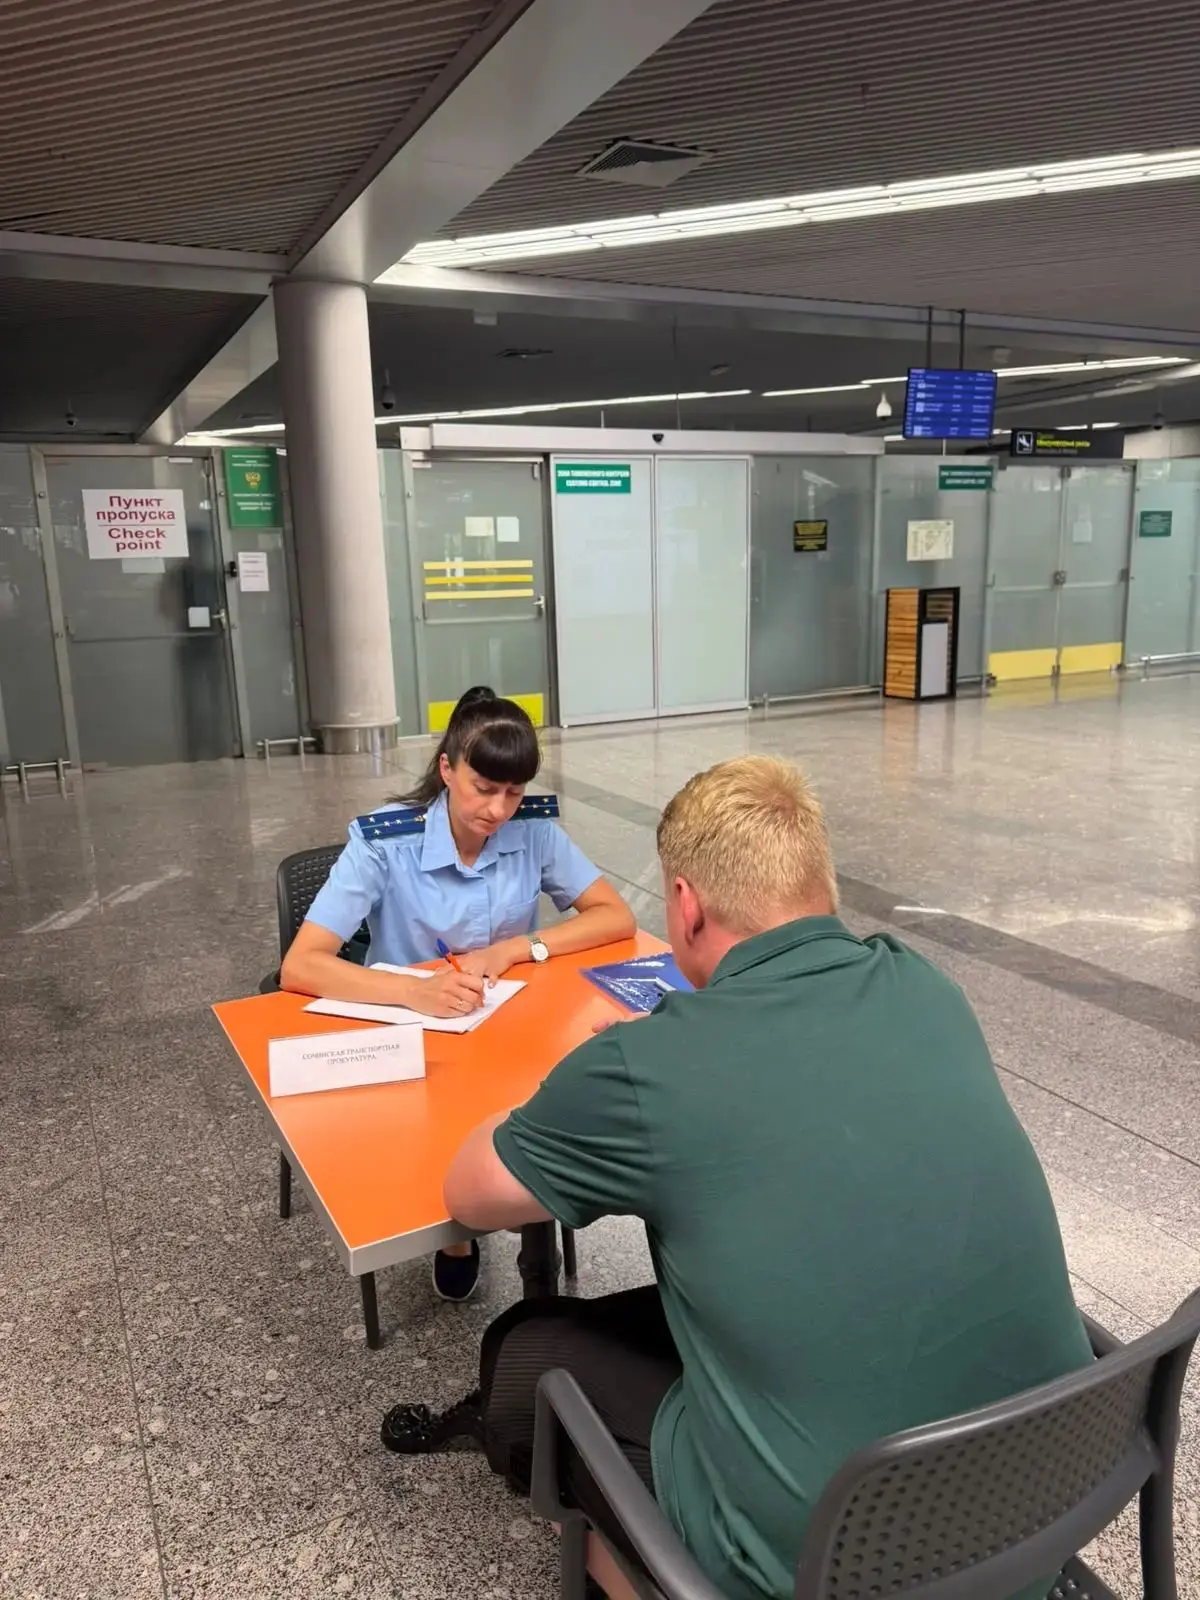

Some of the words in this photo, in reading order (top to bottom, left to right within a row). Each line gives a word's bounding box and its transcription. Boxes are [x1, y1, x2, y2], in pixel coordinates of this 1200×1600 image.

[109, 495, 164, 509] Пункт
[96, 509, 176, 523] пропуска
[108, 527, 167, 540] Check
[115, 539, 163, 552] point
